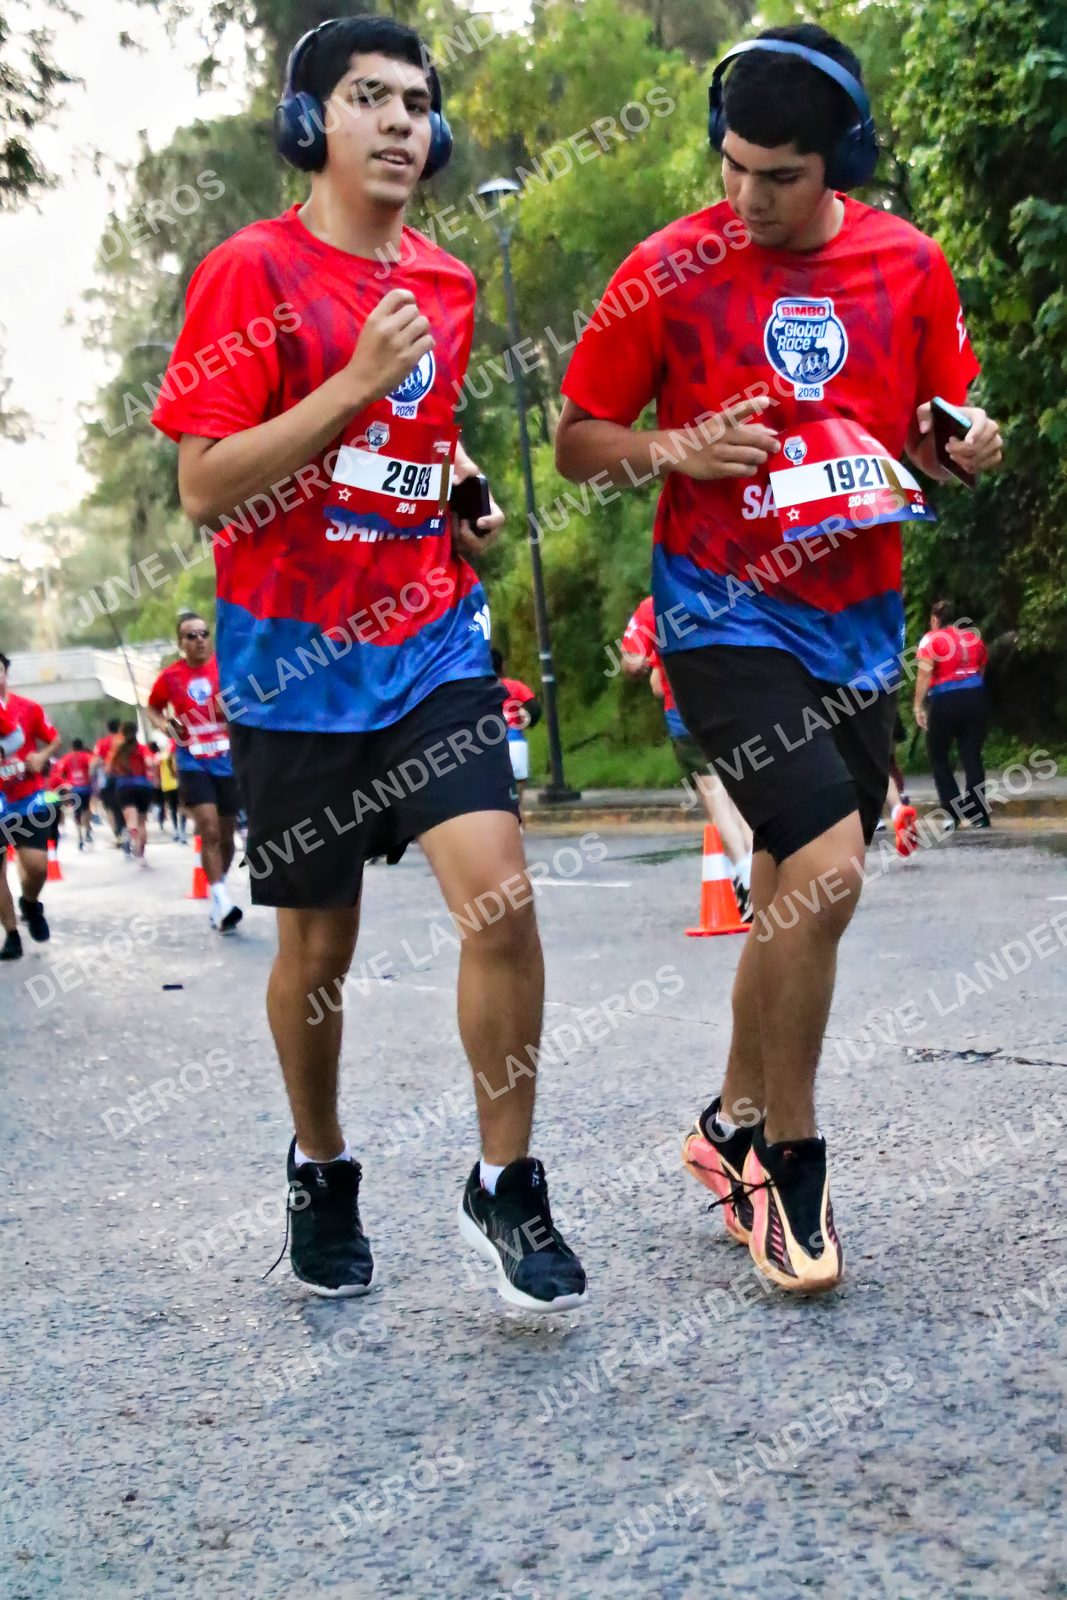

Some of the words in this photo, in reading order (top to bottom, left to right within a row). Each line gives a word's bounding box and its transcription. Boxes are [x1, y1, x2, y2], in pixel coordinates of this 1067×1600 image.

[782, 306, 826, 316] BIMBO
[784, 322, 827, 338] Global
[777, 336, 811, 351] Race
[797, 387, 820, 398] 2026
[395, 405, 416, 417] 2026
[823, 457, 885, 493] 1921
